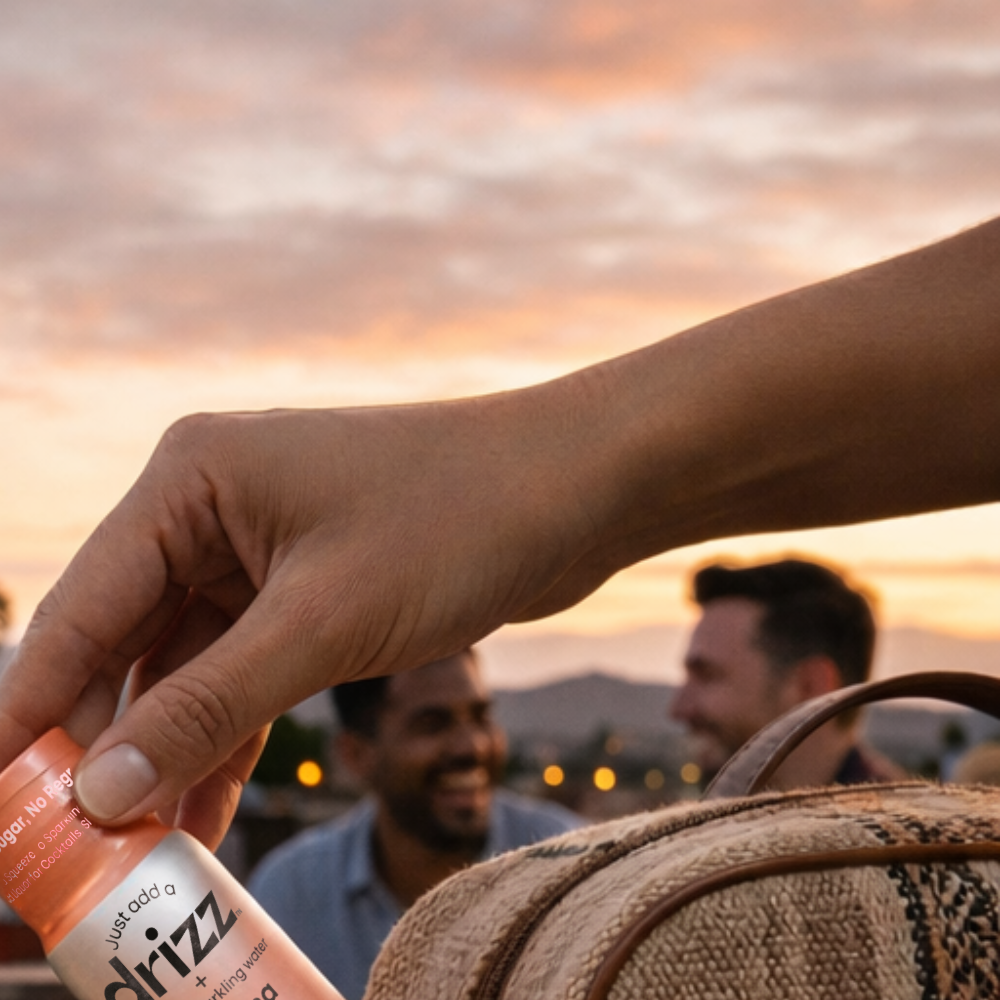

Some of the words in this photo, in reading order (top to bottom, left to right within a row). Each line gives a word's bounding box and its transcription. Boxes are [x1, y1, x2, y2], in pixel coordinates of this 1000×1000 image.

[24, 797, 47, 817] No
[42, 767, 74, 799] Regr
[3, 851, 36, 882] Squeeze
[27, 867, 43, 881] for
[128, 883, 161, 913] add
[164, 883, 176, 896] a
[242, 938, 268, 970] water
